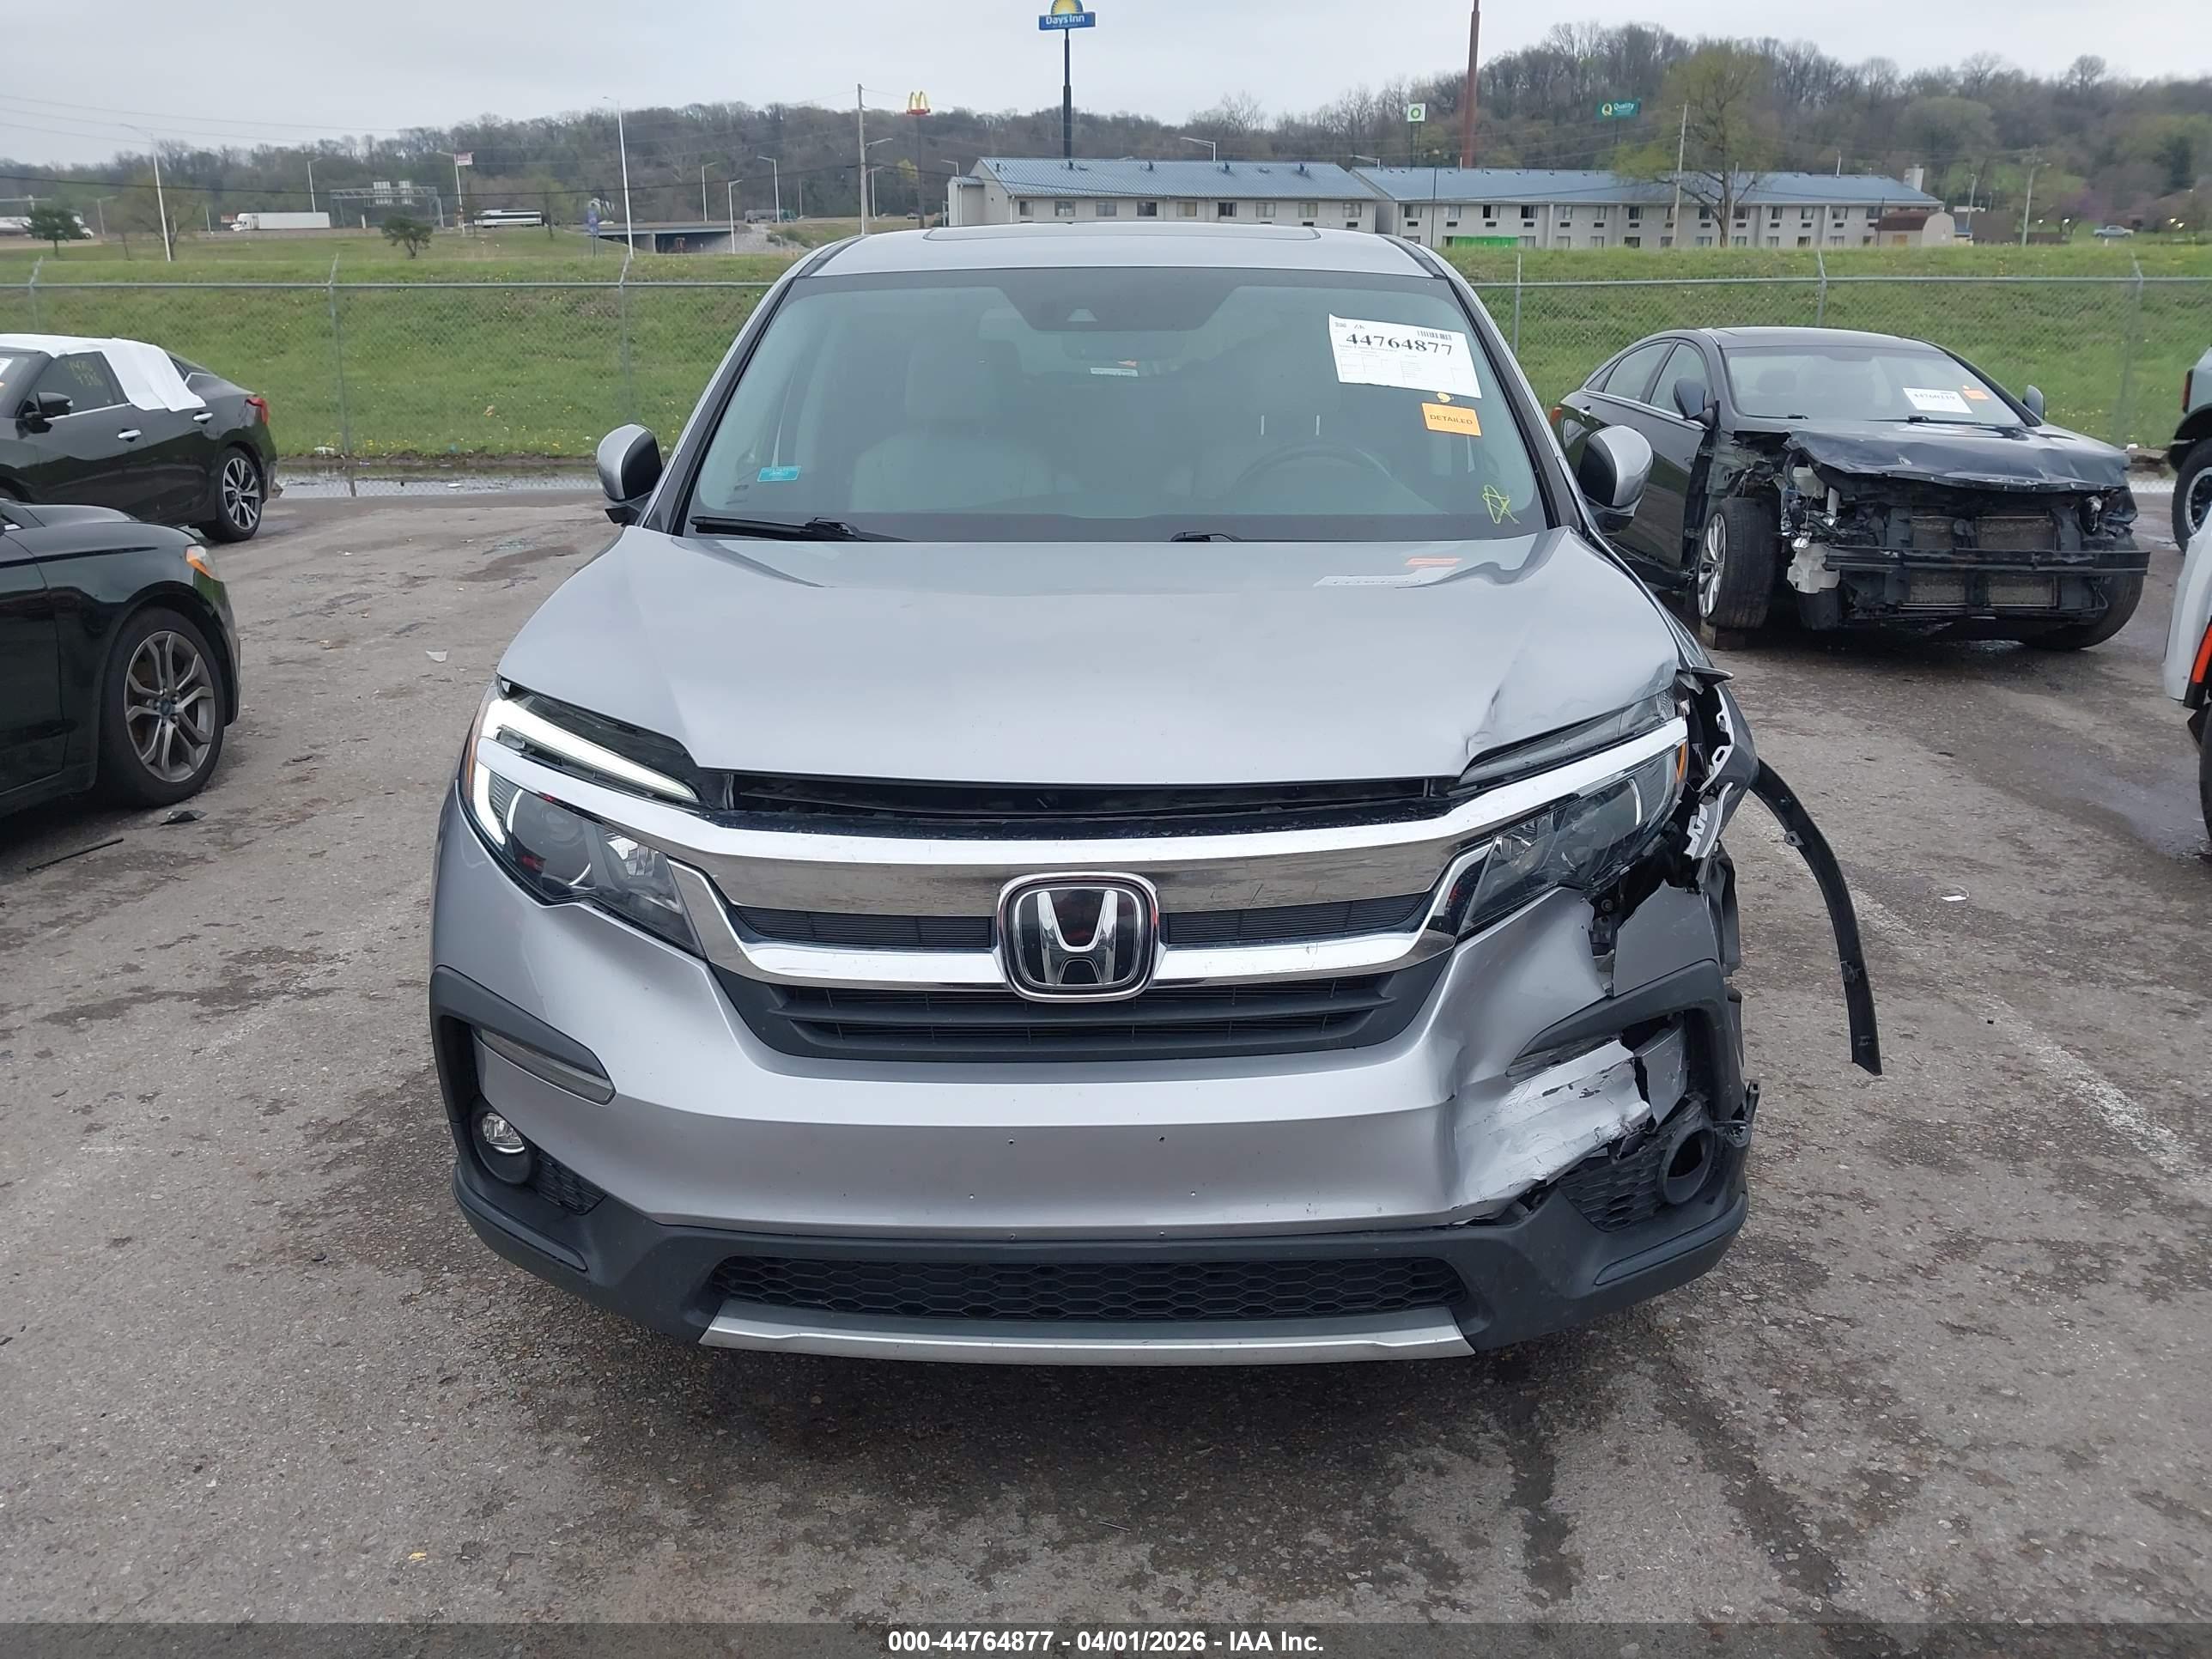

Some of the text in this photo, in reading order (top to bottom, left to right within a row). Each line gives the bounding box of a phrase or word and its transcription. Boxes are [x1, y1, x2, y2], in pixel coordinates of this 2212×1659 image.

[1045, 14, 1085, 25] Days Inn
[1613, 102, 1635, 111] Quality
[1346, 332, 1453, 356] 44764877
[1430, 414, 1473, 425] DETAILED
